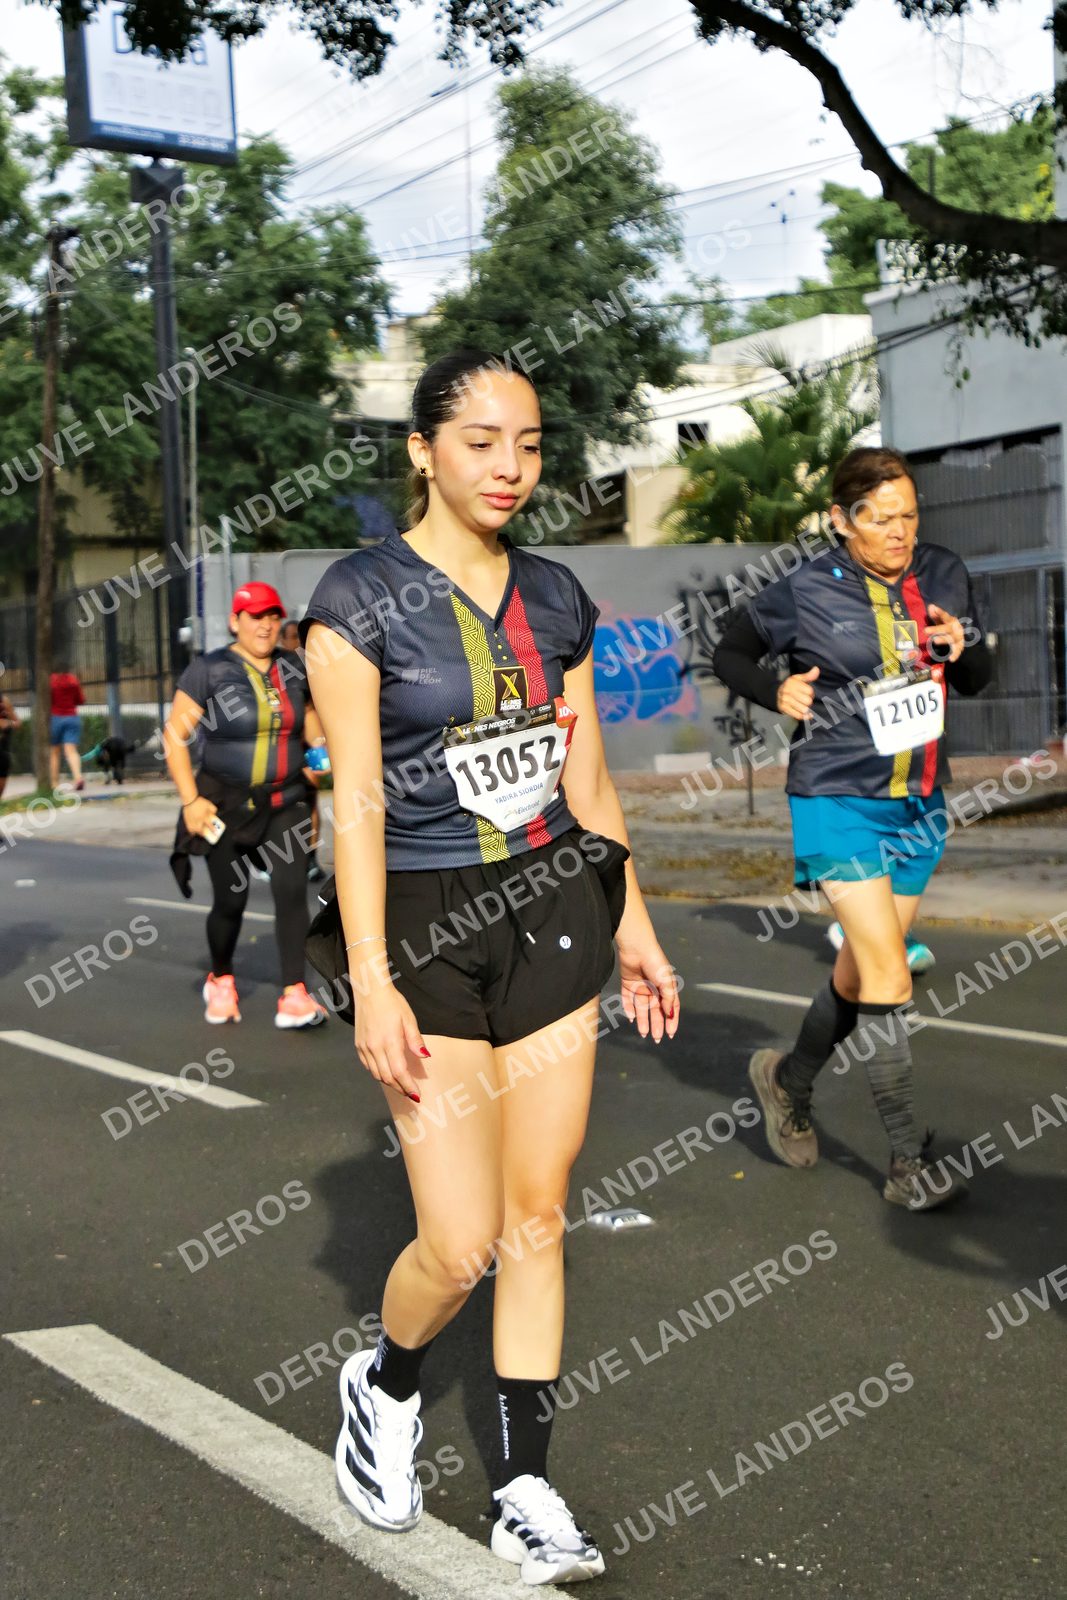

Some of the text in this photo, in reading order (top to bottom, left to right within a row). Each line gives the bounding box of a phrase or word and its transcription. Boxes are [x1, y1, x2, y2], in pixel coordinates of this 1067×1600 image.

[488, 717, 516, 730] NEGROS
[874, 690, 938, 727] 12105
[456, 735, 561, 797] 13052
[494, 782, 544, 804] YADIRA SIORDIA
[498, 1392, 510, 1460] lululemon
